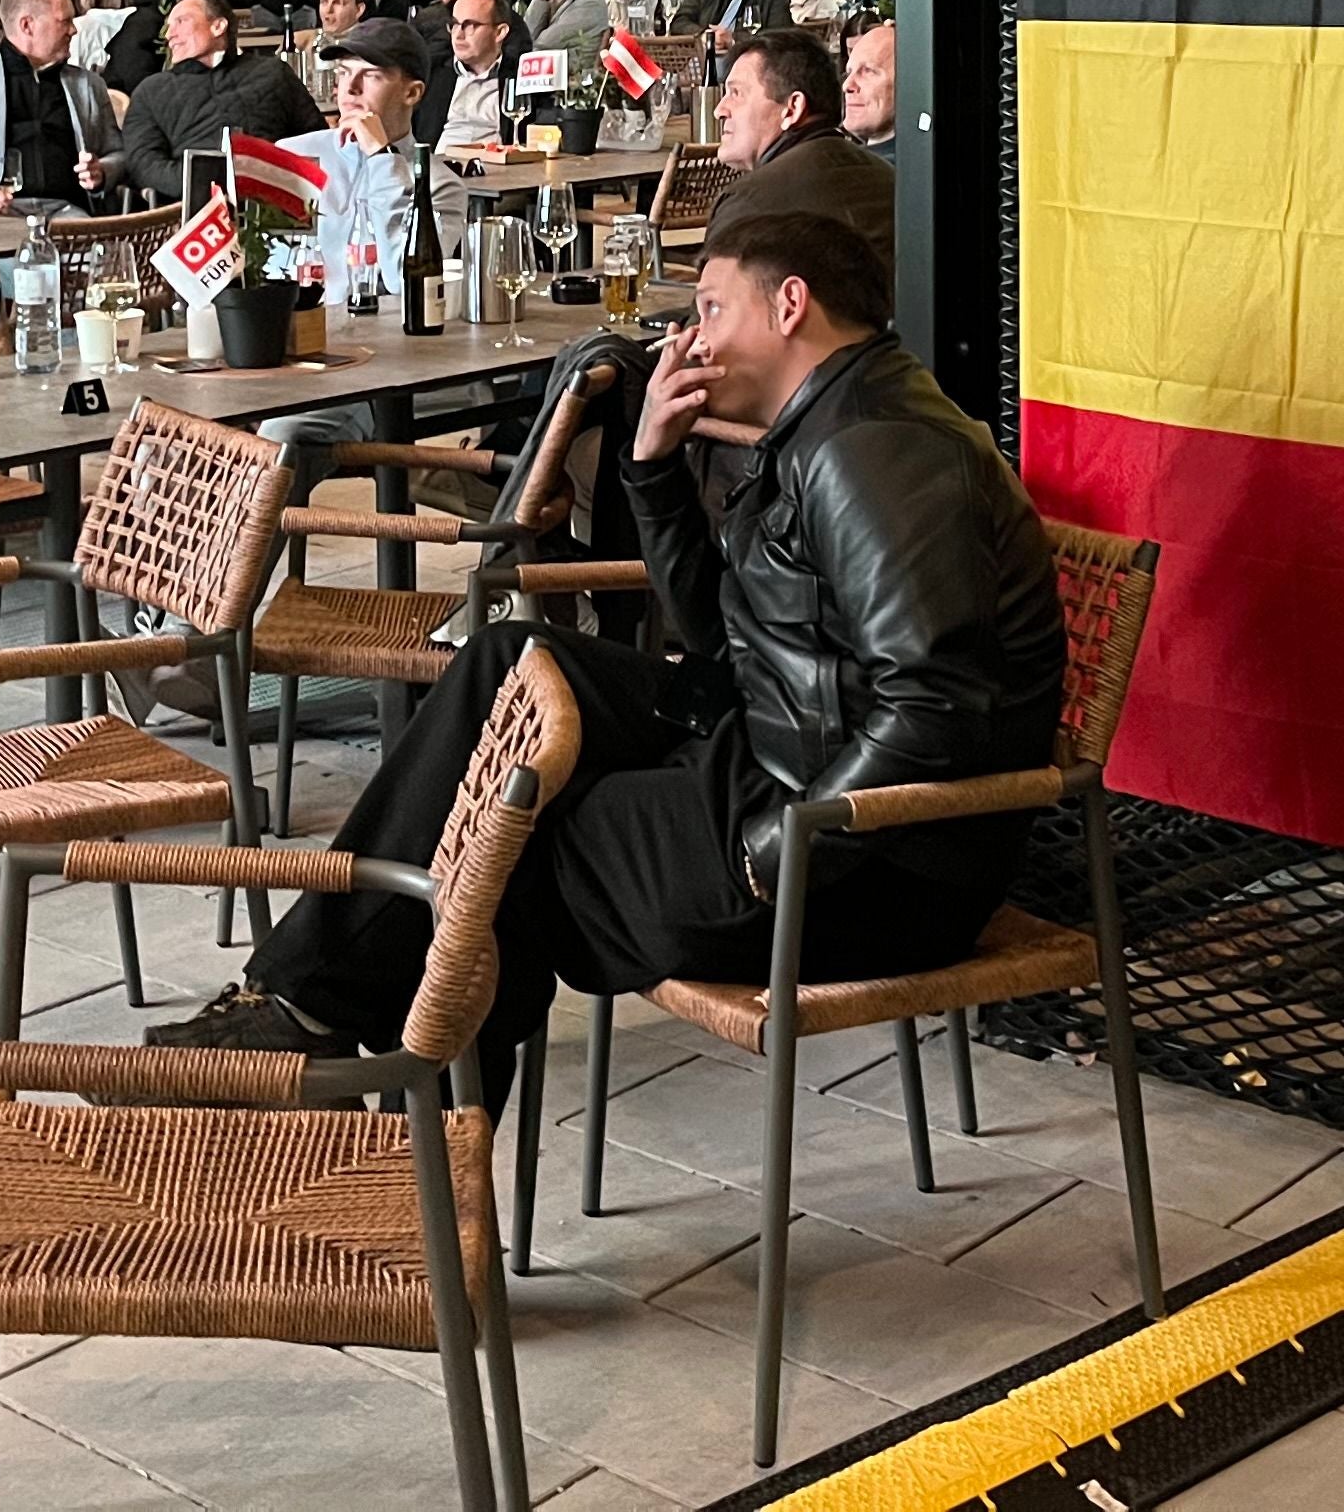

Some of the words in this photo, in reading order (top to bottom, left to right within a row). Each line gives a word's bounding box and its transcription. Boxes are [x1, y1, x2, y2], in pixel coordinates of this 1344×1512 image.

[183, 208, 232, 264] ORF
[199, 259, 232, 289] FÜR
[83, 384, 99, 410] 5
